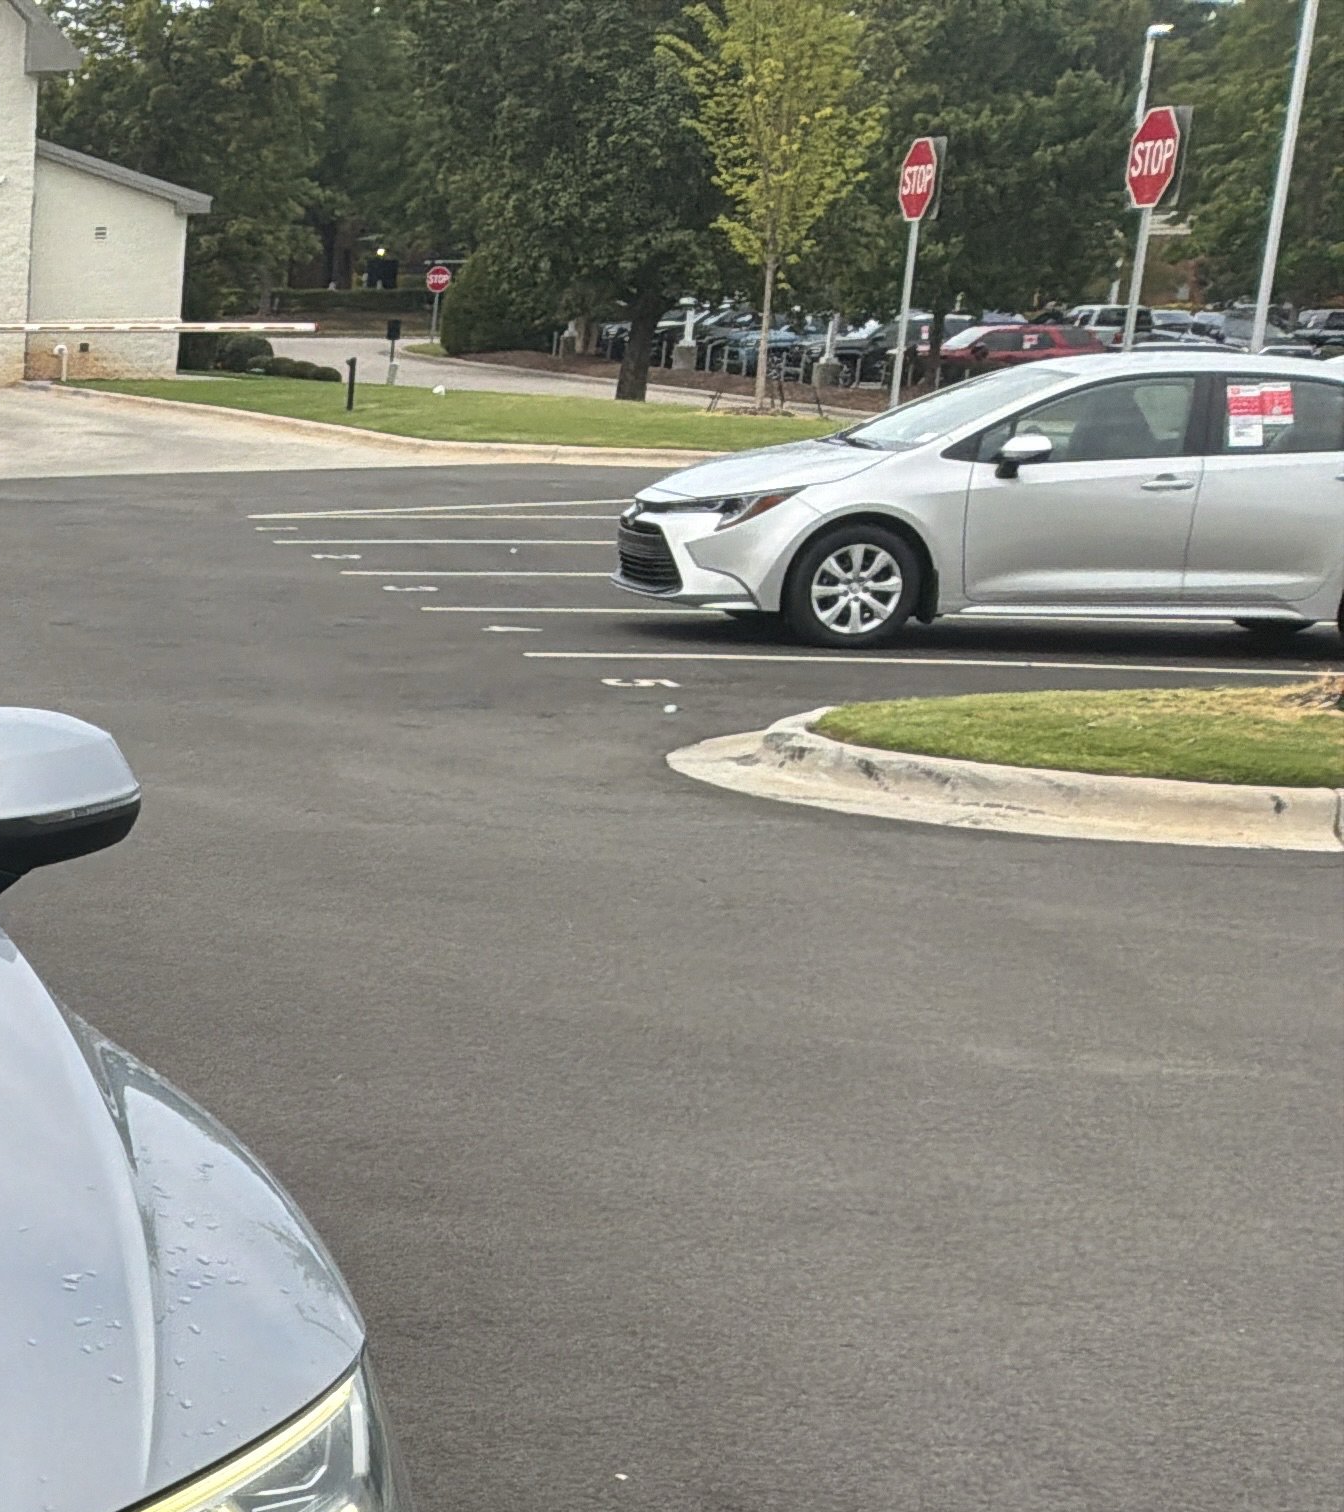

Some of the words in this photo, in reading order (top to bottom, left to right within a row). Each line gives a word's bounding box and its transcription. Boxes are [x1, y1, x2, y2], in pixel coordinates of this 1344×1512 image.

[1131, 139, 1175, 177] STOP
[902, 164, 933, 195] STOP
[429, 274, 450, 285] STOP
[600, 678, 682, 688] 5
